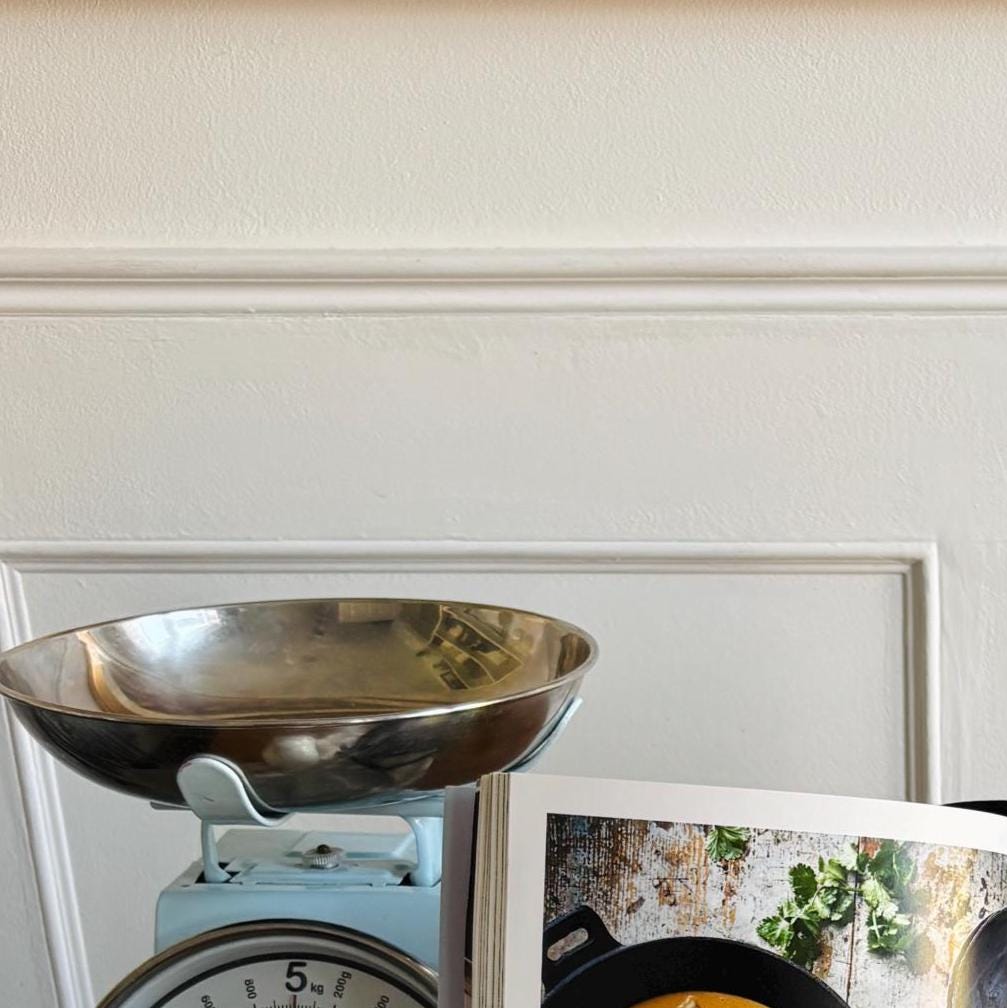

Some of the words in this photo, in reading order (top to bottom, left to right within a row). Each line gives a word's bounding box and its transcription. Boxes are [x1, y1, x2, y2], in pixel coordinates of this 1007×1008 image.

[244, 979, 257, 1000] 800
[285, 962, 308, 992] 5
[310, 982, 324, 995] kg
[333, 970, 352, 998] 200g
